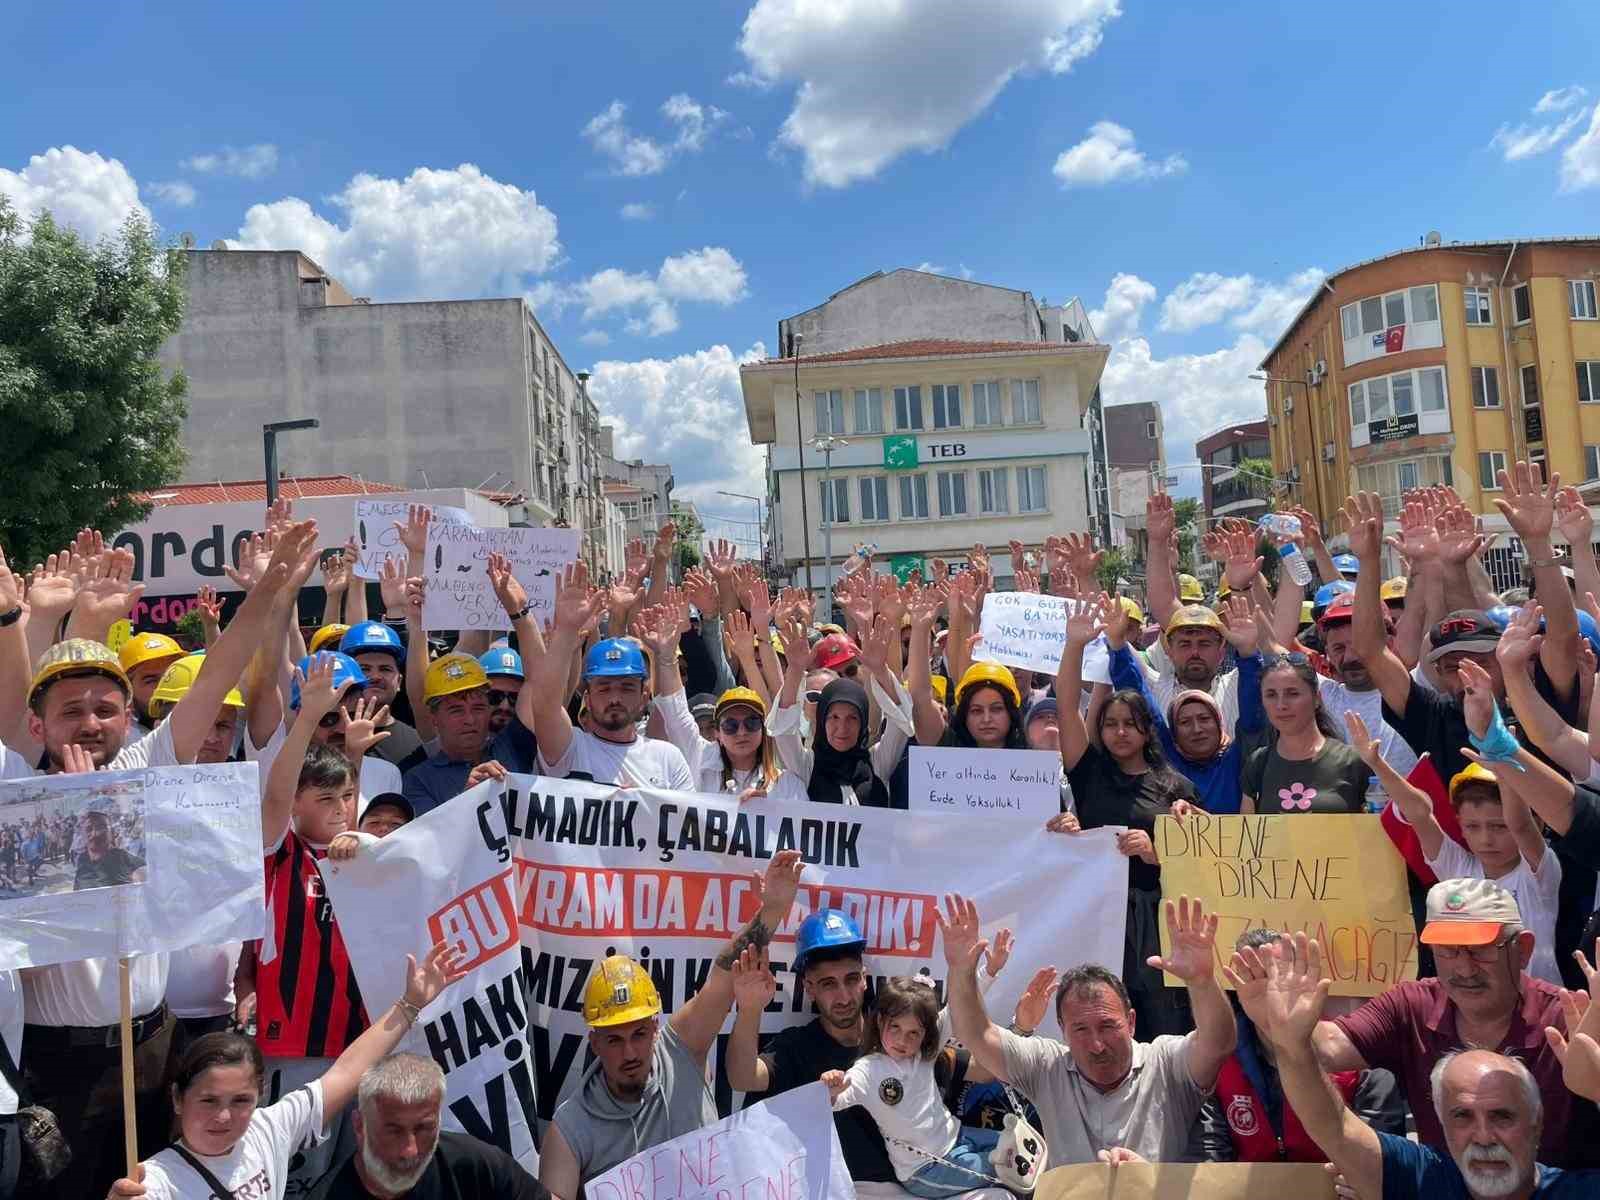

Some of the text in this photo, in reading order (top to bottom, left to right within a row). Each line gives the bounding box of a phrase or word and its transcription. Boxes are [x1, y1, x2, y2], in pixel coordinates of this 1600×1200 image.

[928, 444, 966, 457] TEB
[1023, 608, 1066, 622] BAYRA
[927, 762, 946, 779] Yer
[929, 790, 955, 804] Evde
[657, 803, 862, 868] ÇABALADIK
[1163, 816, 1278, 858] DİRENE
[1214, 857, 1348, 900] DİRENE
[438, 885, 510, 970] BU
[504, 862, 624, 929] YRAM
[633, 872, 687, 931] DA
